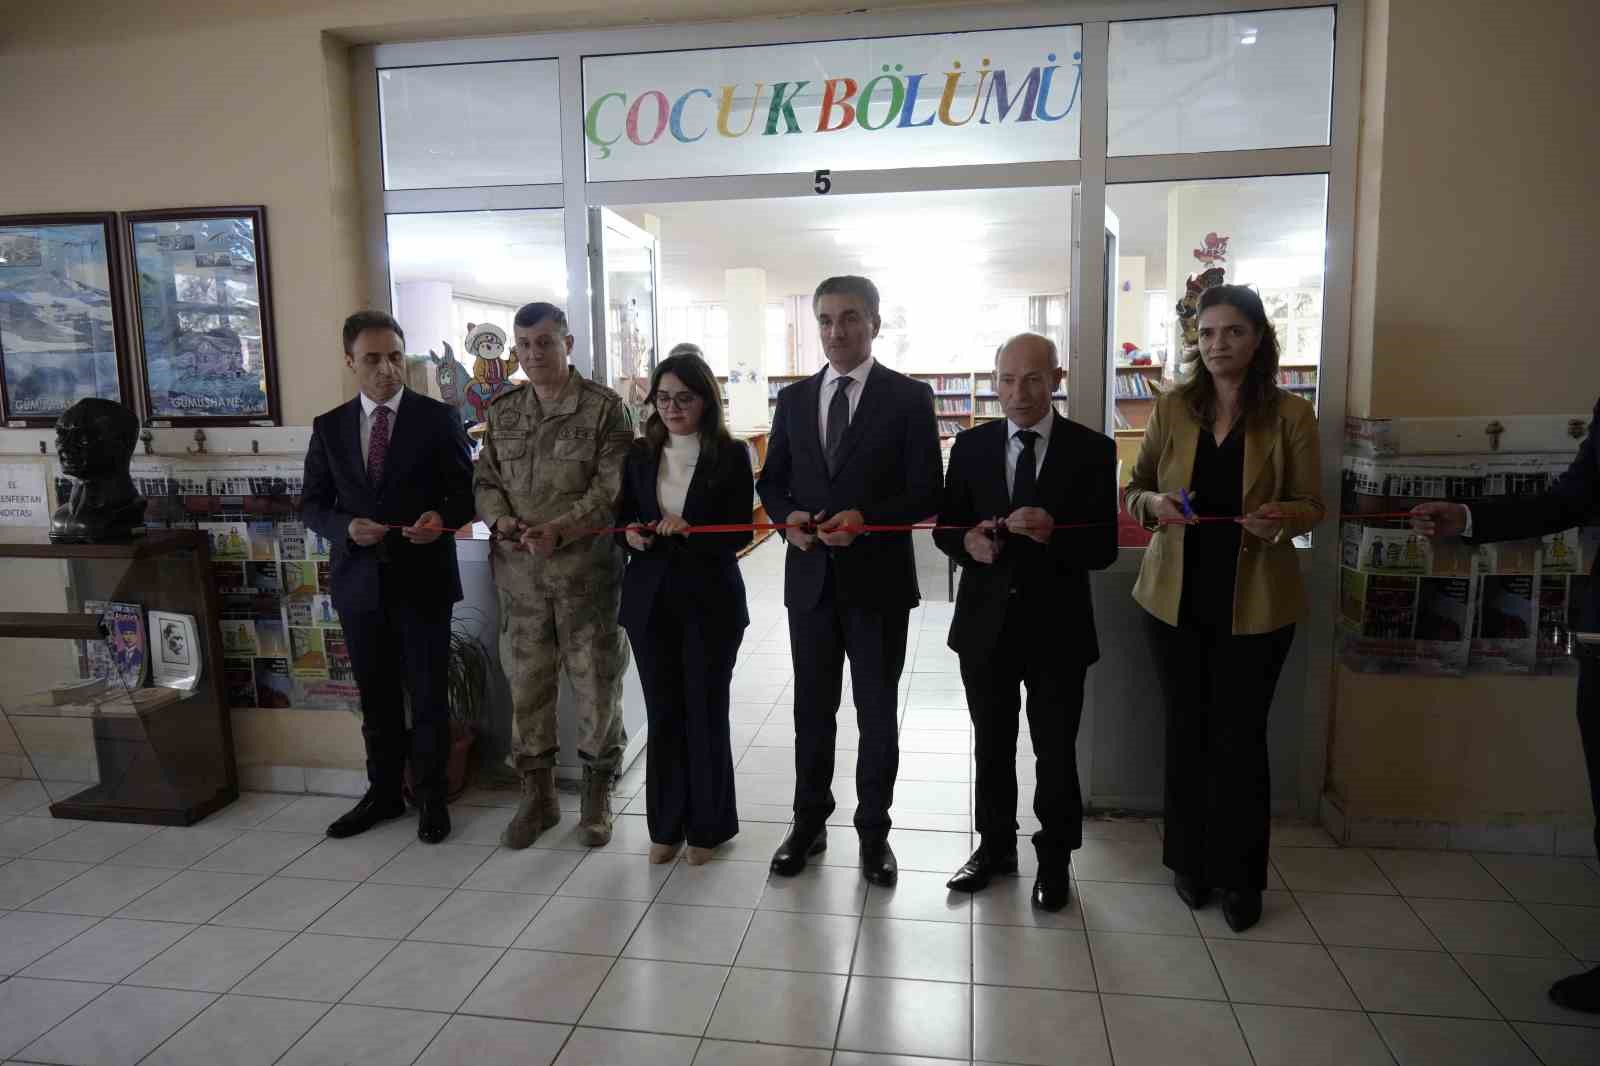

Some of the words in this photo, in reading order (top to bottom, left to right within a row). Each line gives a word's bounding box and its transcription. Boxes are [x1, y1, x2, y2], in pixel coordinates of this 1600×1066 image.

[584, 79, 811, 159] ÇOCUK
[814, 51, 1082, 134] BÖLÜMÜ
[813, 169, 831, 195] 5
